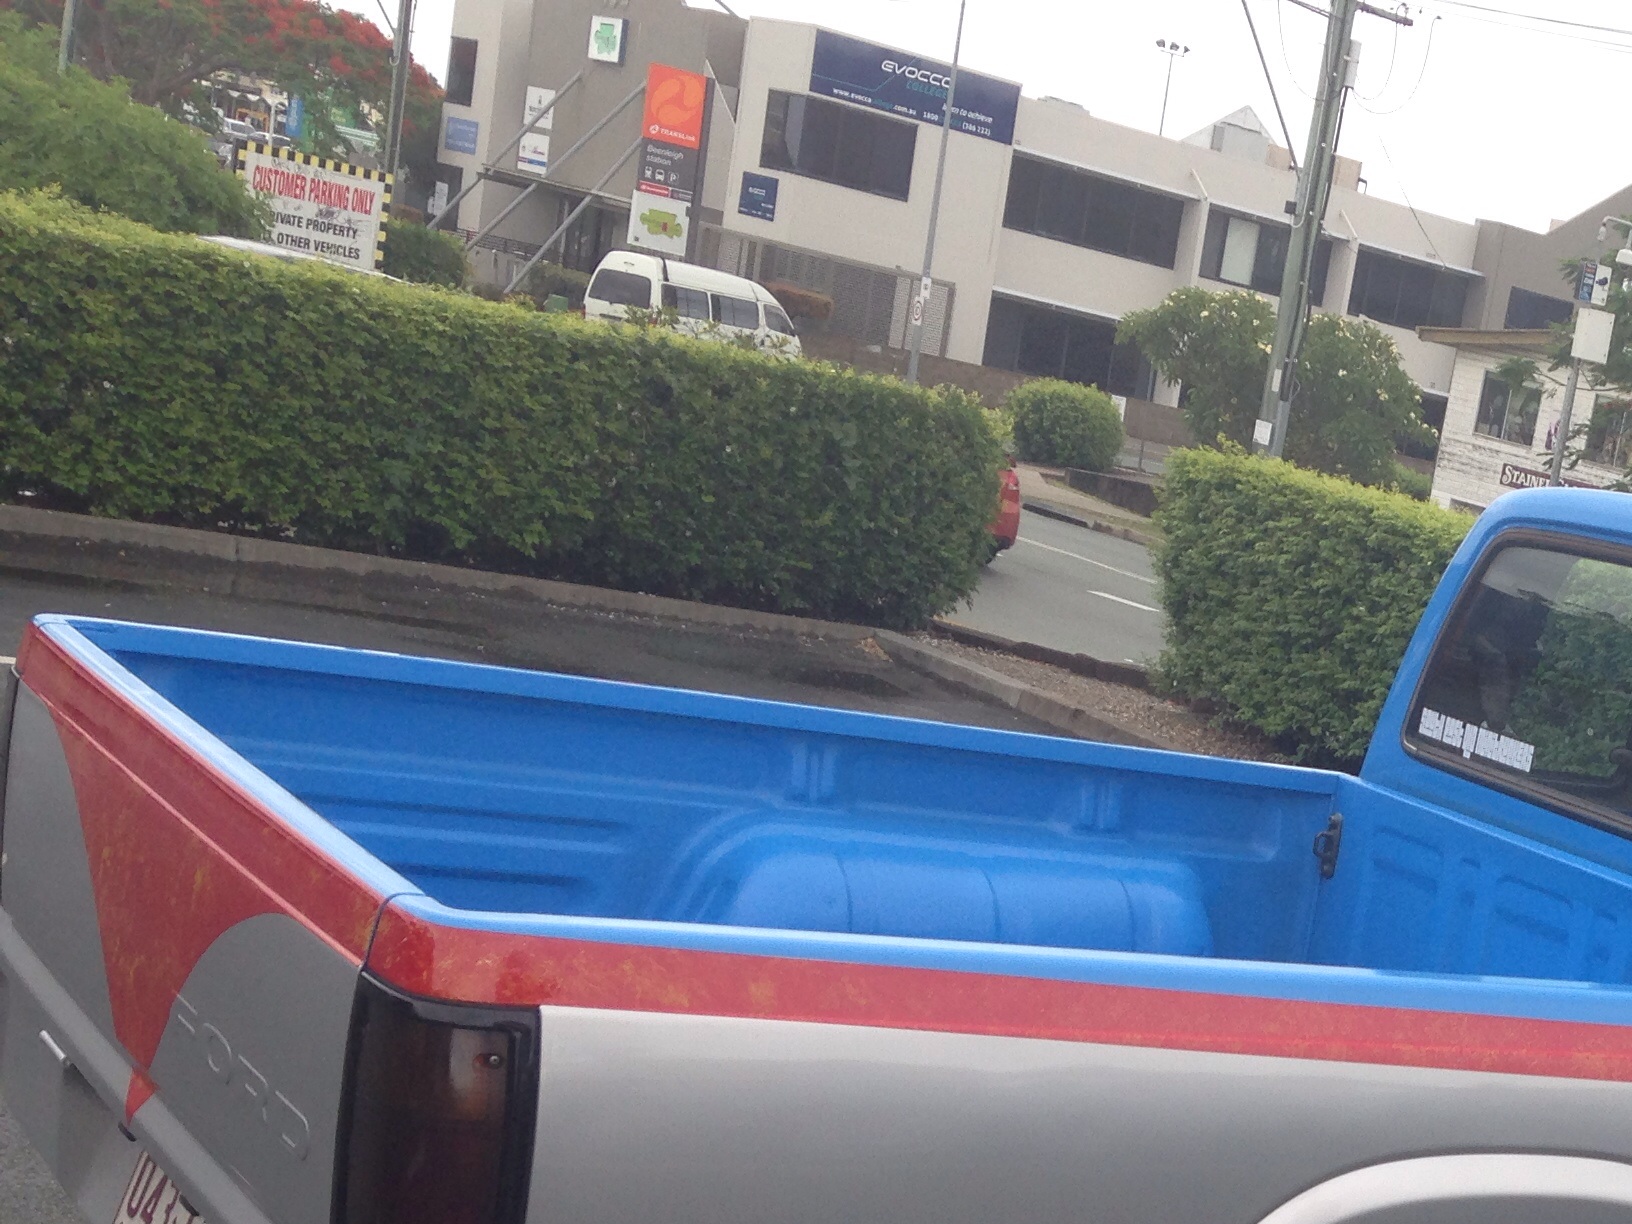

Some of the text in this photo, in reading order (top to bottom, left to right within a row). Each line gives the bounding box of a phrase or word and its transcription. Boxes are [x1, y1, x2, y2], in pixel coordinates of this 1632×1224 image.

[253, 164, 307, 202] CUSTOMER
[308, 177, 350, 211] PARKING
[351, 187, 376, 216] ONLY
[277, 232, 310, 250] OTHER
[313, 239, 360, 260] VEHICLES
[305, 218, 358, 240] PROPERTY
[172, 988, 310, 1163] FORD
